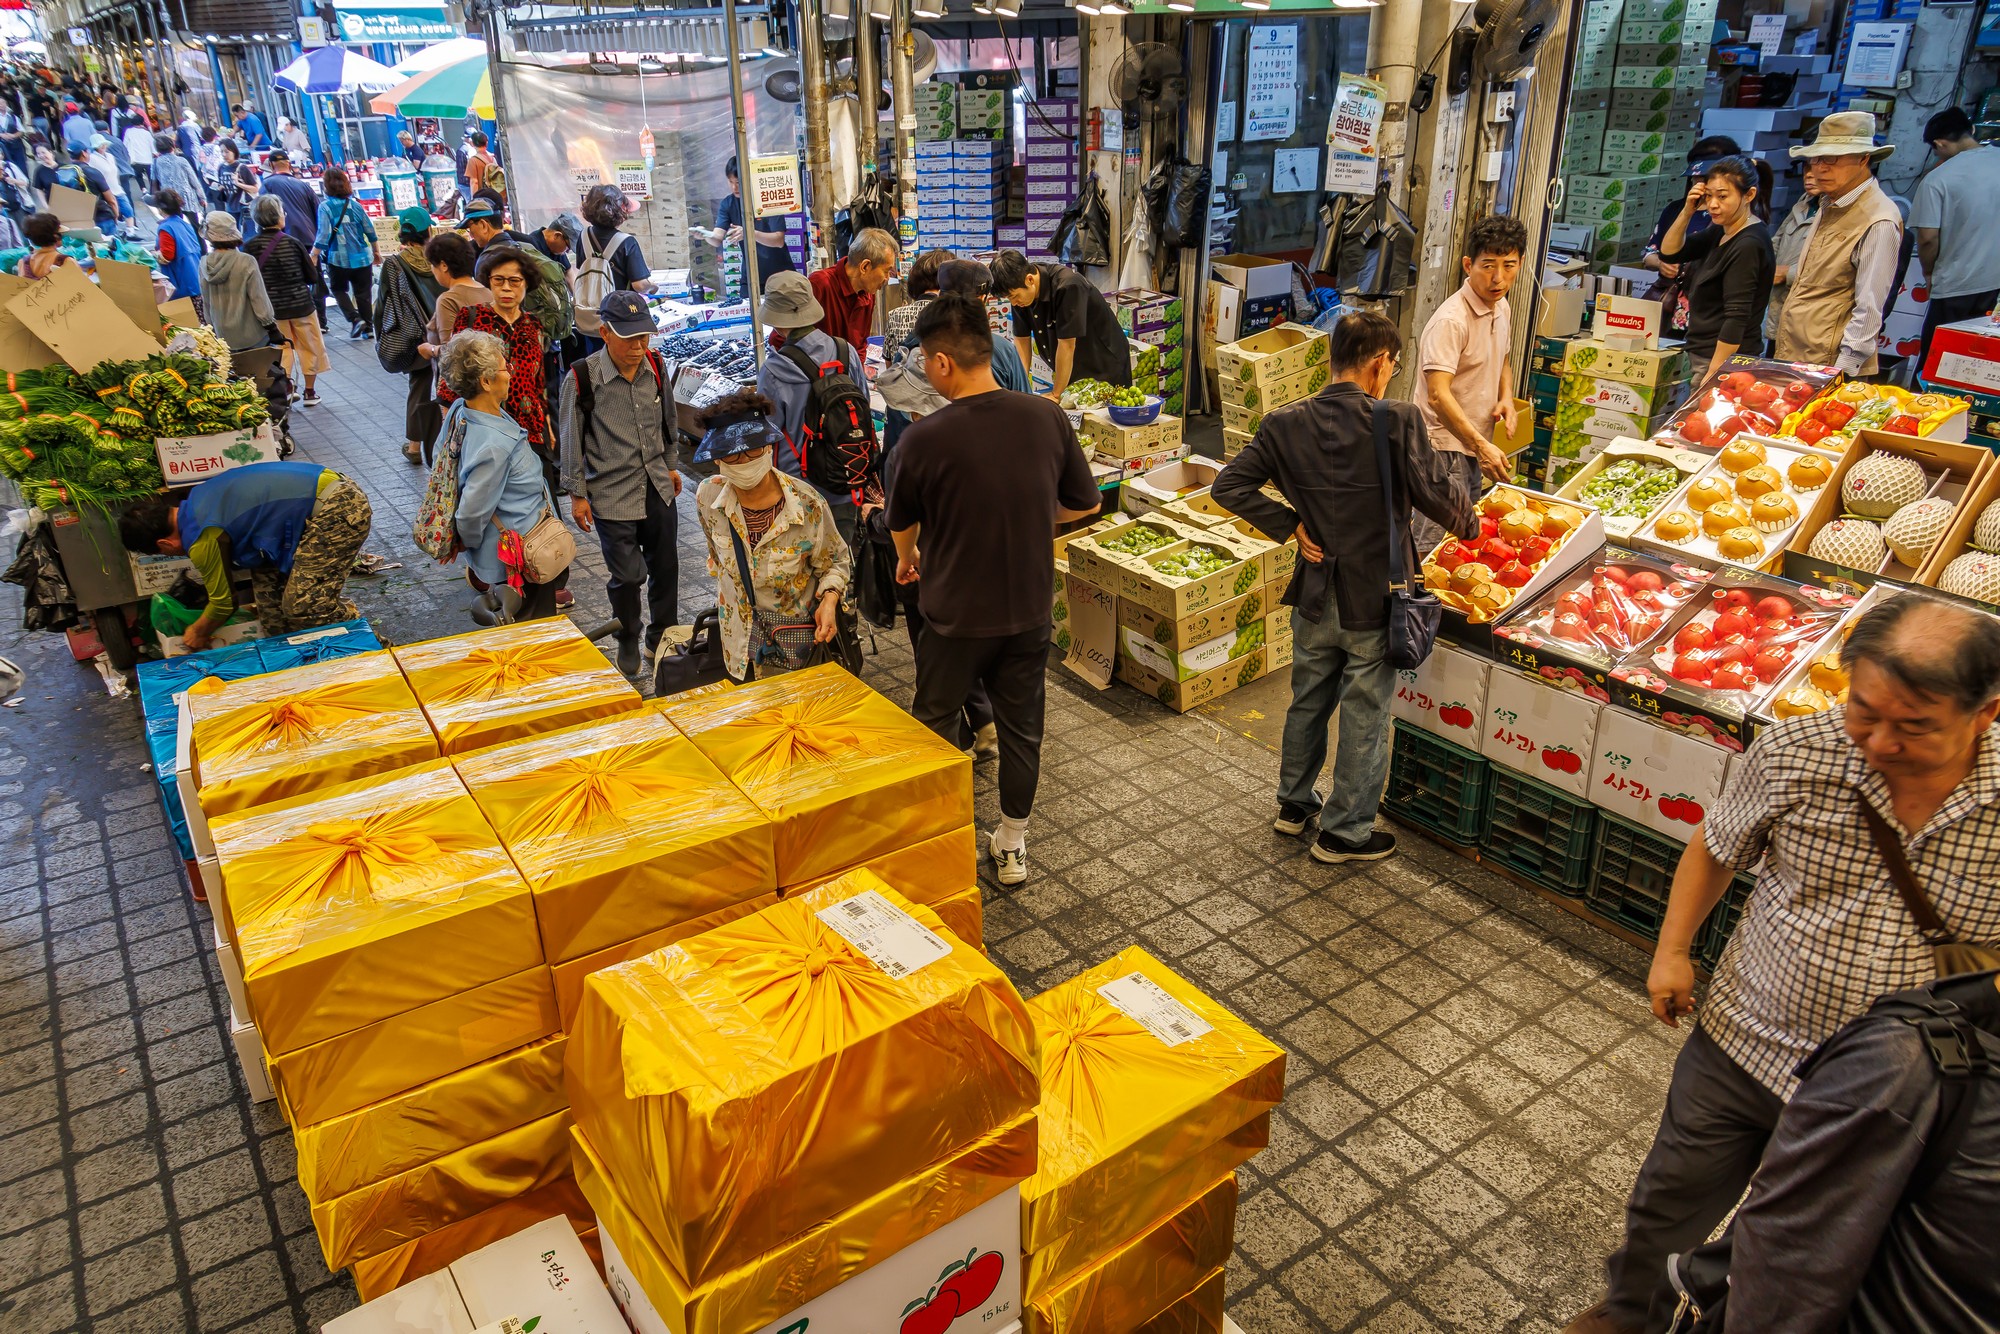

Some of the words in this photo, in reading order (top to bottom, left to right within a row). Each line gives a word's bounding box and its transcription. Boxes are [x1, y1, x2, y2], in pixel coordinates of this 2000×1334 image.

[1270, 29, 1277, 41] 9
[1340, 100, 1376, 120] 환급행사
[1336, 114, 1372, 137] 참여점포
[620, 173, 646, 182] 환급행사
[620, 183, 647, 191] 참여점포
[759, 175, 793, 189] 환급행사
[761, 188, 794, 202] 참여점포
[1608, 316, 1642, 329] Supreme
[1878, 335, 1891, 348] 과
[180, 456, 225, 472] 시금치
[1070, 638, 1084, 664] 14
[1195, 642, 1228, 661] 샤인머스켓
[1510, 648, 1538, 667] 사과
[1398, 669, 1417, 684] 산골
[1398, 687, 1435, 710] 사과
[1629, 693, 1660, 712] 사과
[1494, 708, 1518, 725] 산골
[1494, 728, 1537, 754] 사과
[1604, 751, 1632, 770] 산골
[1603, 772, 1653, 801] 사과
[981, 1310, 994, 1323] 15
[994, 1301, 1010, 1316] kg
